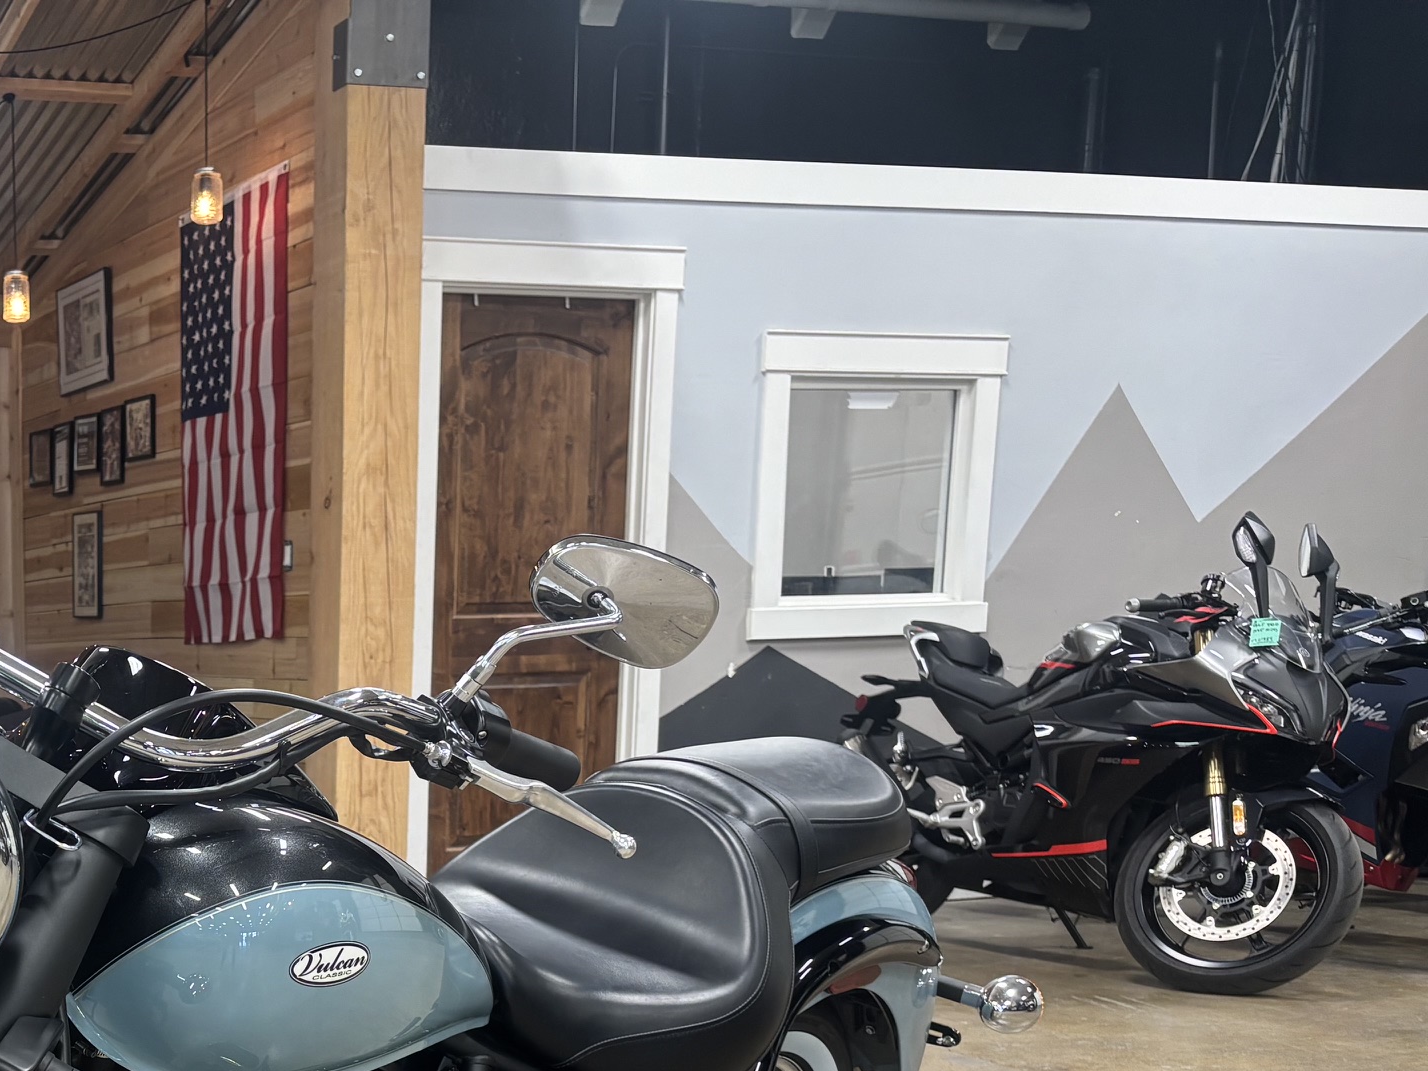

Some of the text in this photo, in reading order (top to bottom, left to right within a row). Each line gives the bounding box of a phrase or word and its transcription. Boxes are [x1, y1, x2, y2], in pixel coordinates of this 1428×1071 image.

[1351, 697, 1388, 722] inja
[298, 947, 366, 977] Vulcan
[312, 969, 352, 980] CLASSIC
